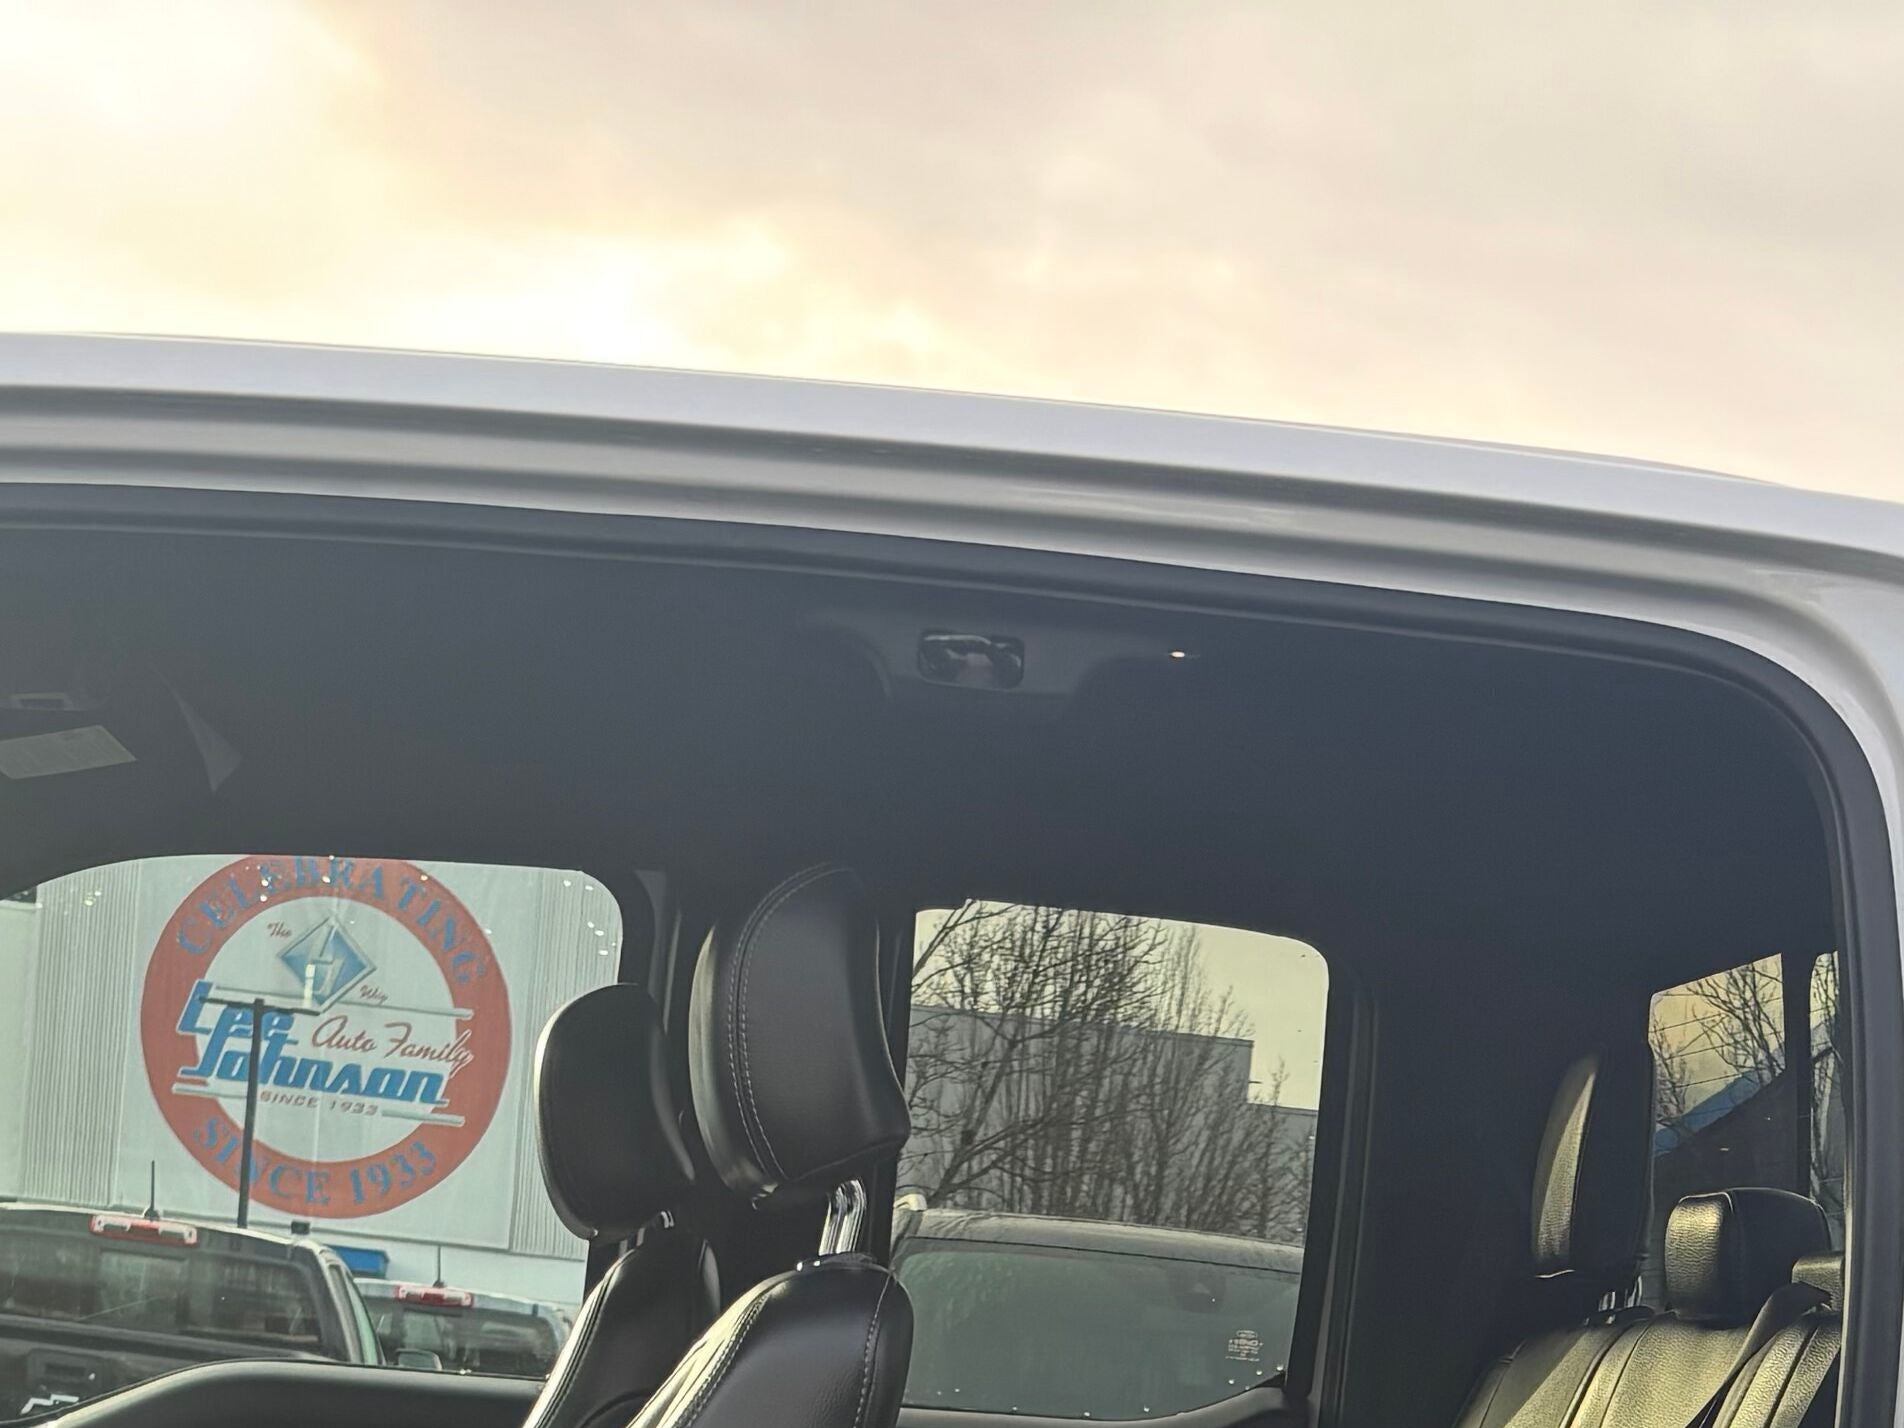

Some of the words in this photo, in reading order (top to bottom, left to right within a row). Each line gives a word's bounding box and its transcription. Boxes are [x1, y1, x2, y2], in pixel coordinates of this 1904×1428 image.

[176, 856, 487, 984] CELEBRATING
[266, 920, 293, 940] The
[178, 980, 298, 1042] Lee
[179, 1030, 450, 1106] Johnson
[311, 1014, 378, 1052] Auto
[382, 1021, 473, 1079] Family
[259, 1089, 320, 1110] SINCE
[328, 1098, 380, 1117] 1933
[195, 1117, 331, 1206] SINCE
[348, 1140, 438, 1205] 1933
